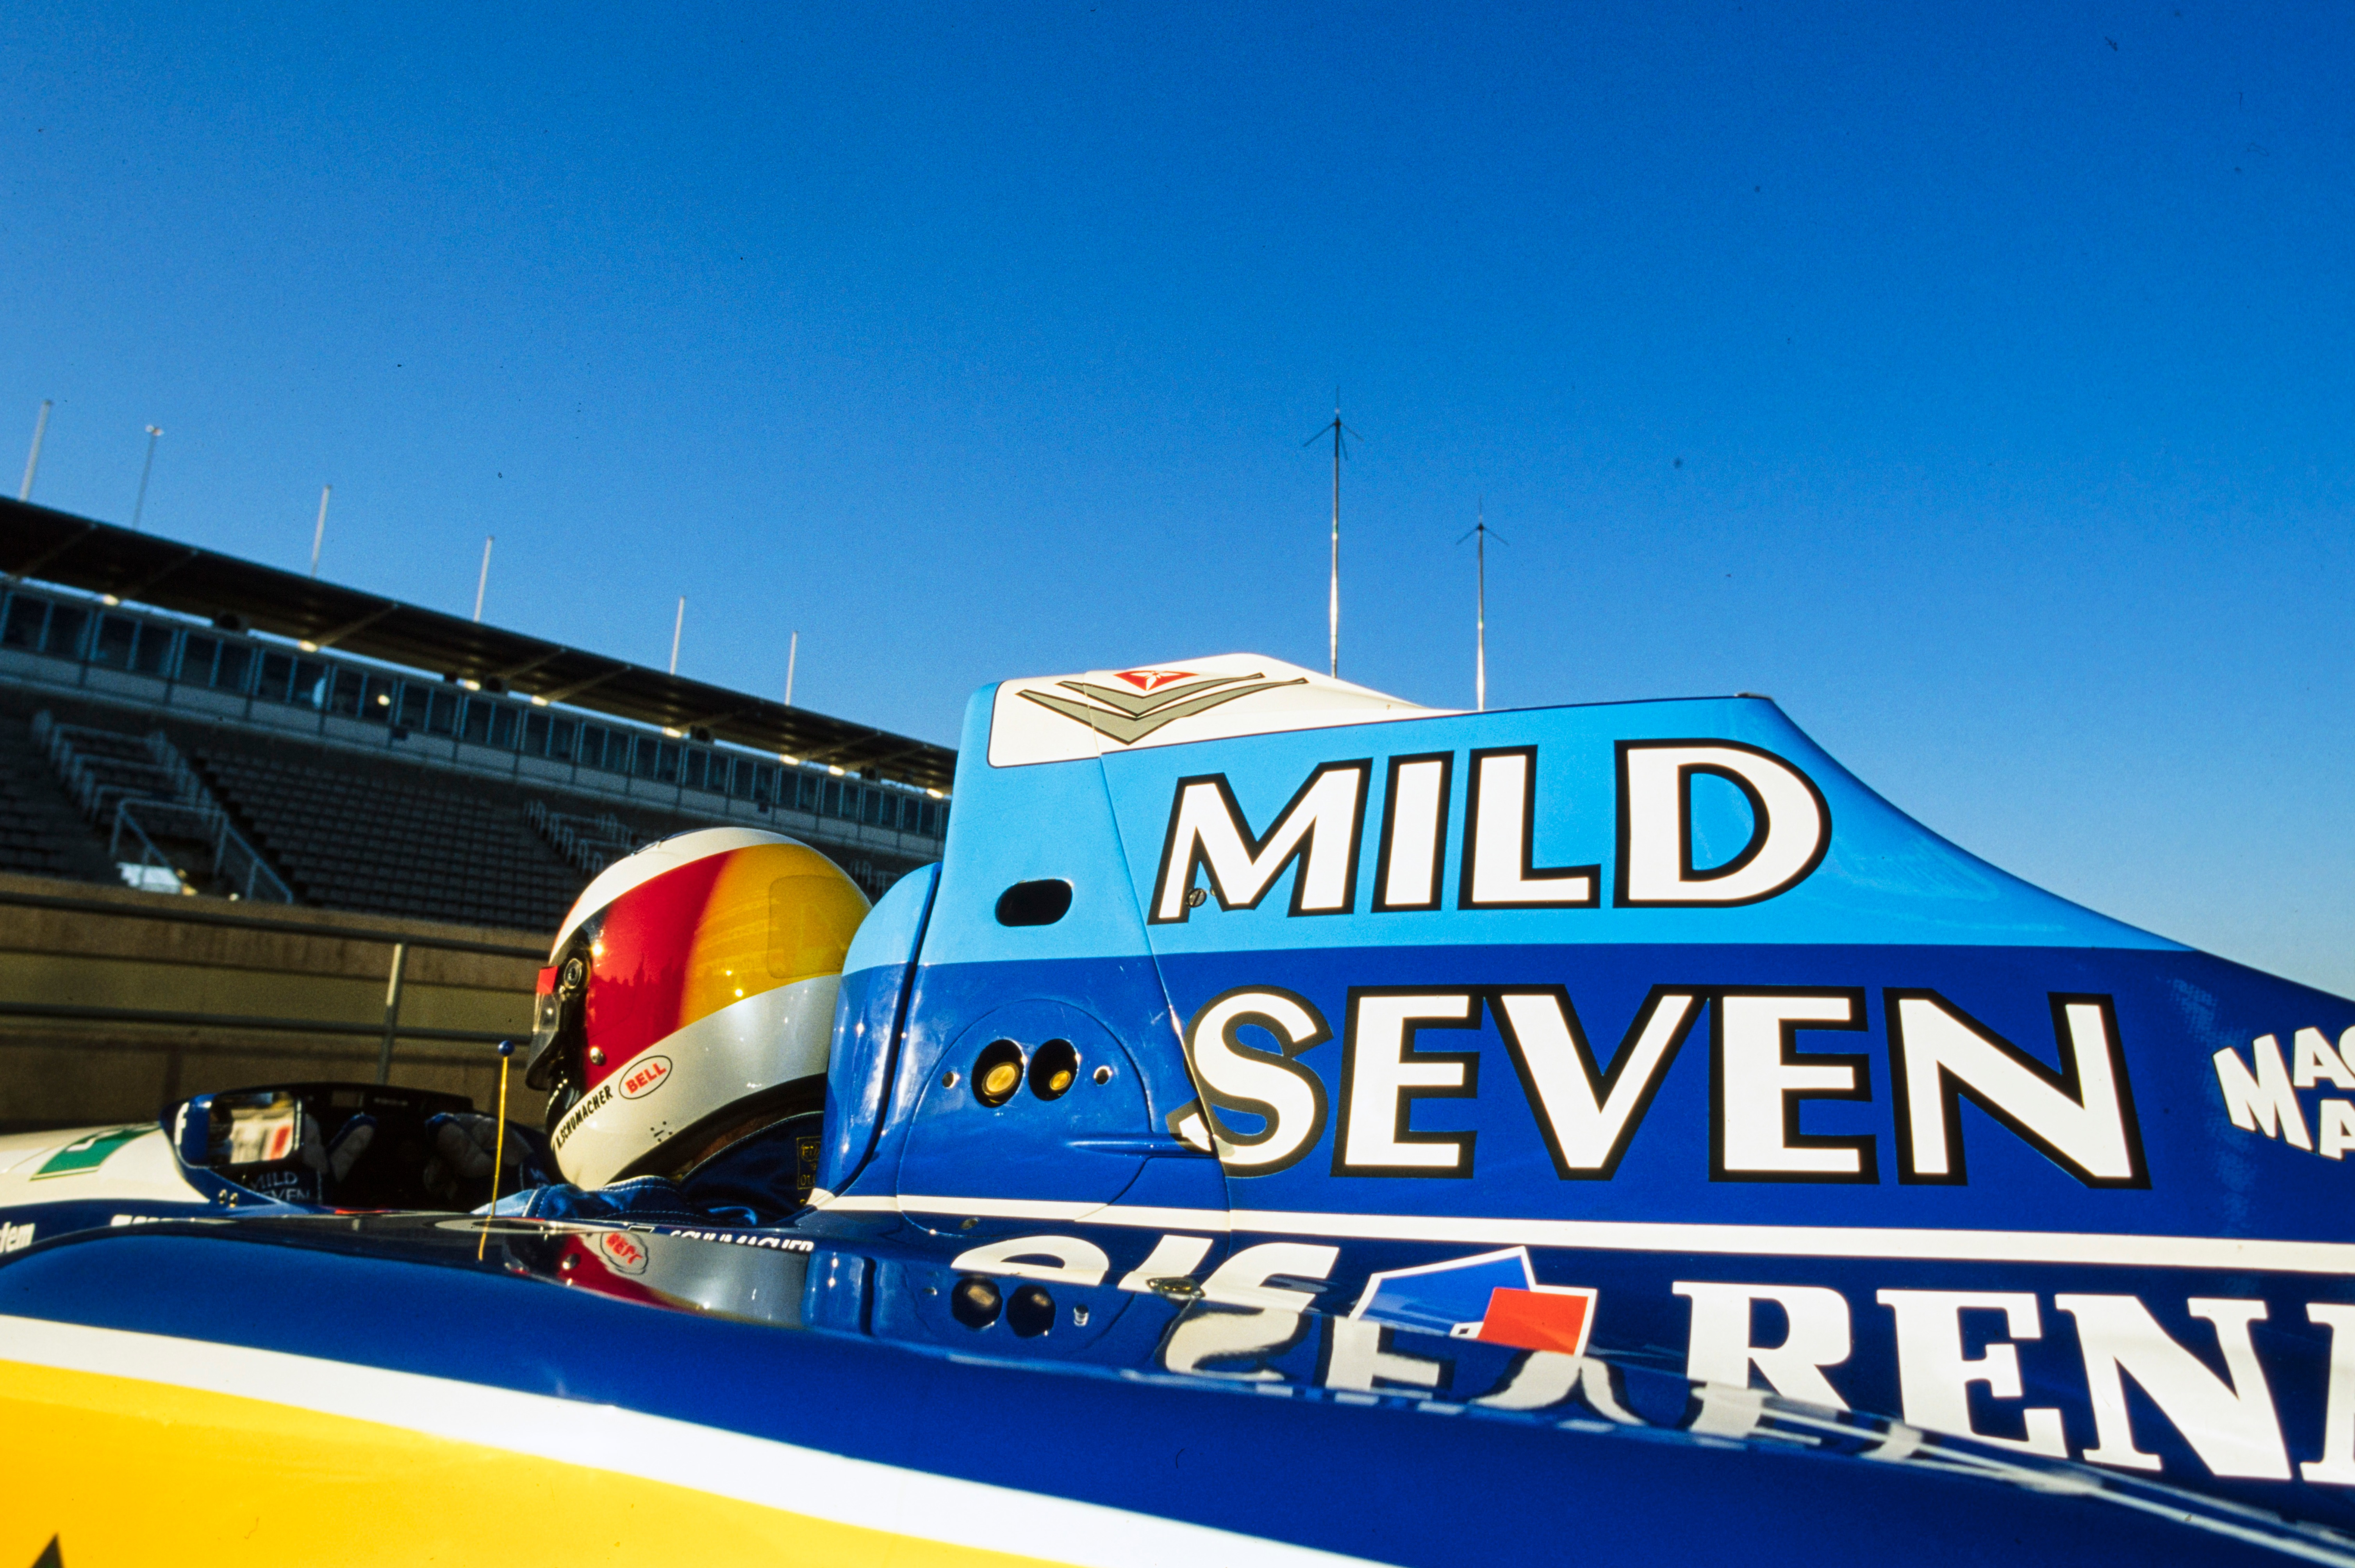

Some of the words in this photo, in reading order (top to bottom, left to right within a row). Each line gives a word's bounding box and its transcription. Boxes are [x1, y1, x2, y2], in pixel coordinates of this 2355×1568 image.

[1147, 737, 1832, 925] MILD
[625, 1063, 667, 1094] BELL
[1166, 985, 2151, 1190] SEVEN
[2212, 1023, 2355, 1152] MA
[0, 1221, 36, 1254] tem
